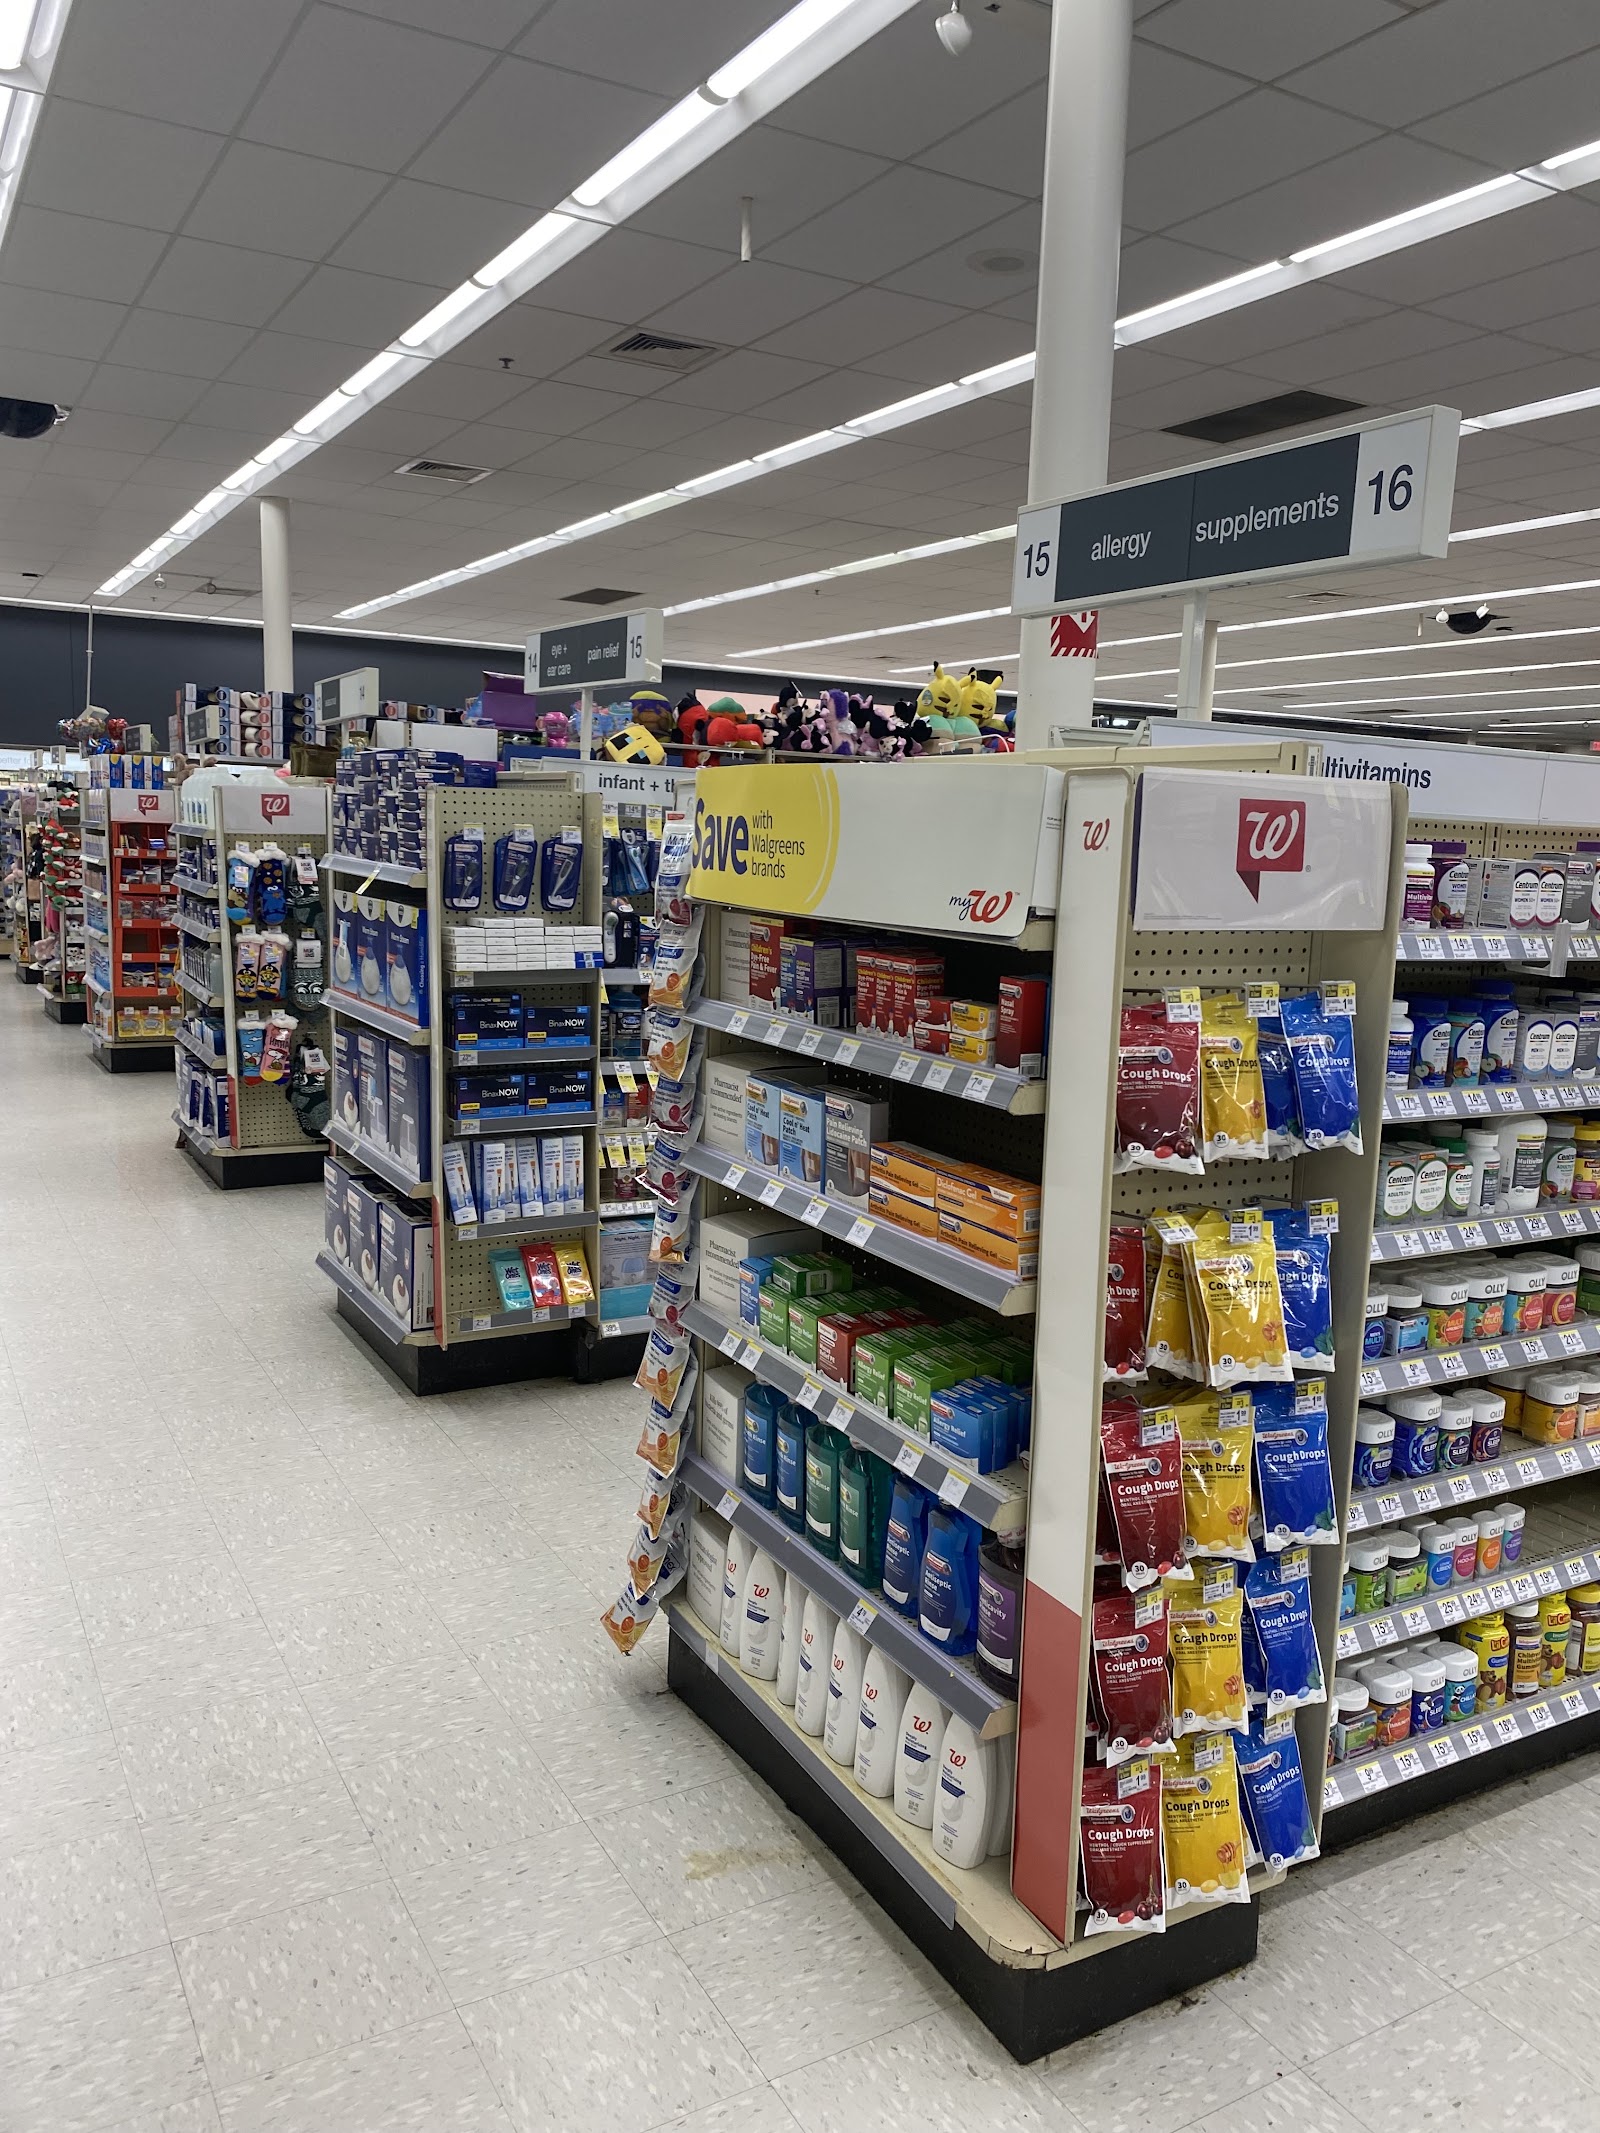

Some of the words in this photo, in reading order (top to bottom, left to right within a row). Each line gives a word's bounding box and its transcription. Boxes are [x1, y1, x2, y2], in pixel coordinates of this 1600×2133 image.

[1367, 464, 1413, 515] 16
[1195, 491, 1340, 543] supplements
[1091, 529, 1151, 561] allergy
[1023, 540, 1050, 578] 15
[552, 644, 562, 658] eye
[630, 636, 642, 658] 15
[588, 647, 601, 664] pain
[603, 642, 620, 658] relief
[528, 653, 537, 673] 14
[547, 666, 555, 677] ear
[558, 663, 571, 675] care
[1322, 756, 1431, 788] ltivitamins
[599, 774, 645, 791] infant
[752, 810, 773, 830] with
[692, 798, 749, 875] Save
[1245, 809, 1299, 860] W
[752, 834, 805, 857] Walgreens
[752, 856, 786, 879] brands
[1515, 881, 1539, 889] Centrum
[1541, 881, 1563, 890] Centrum
[1001, 999, 1014, 1008] Nasal
[1001, 1006, 1014, 1016] Spray
[480, 1021, 518, 1029] BinaxNOW
[549, 1019, 585, 1027] BinaxNOW
[1205, 1058, 1235, 1069] Cough
[1237, 1058, 1258, 1069] Drops
[1298, 1057, 1328, 1068] Cough
[1330, 1057, 1350, 1068] Drop
[1121, 1068, 1160, 1081] Cough
[1162, 1070, 1192, 1082] Drops
[550, 1085, 585, 1094] BinaxNOW
[714, 1077, 739, 1091] Pharmacist
[482, 1088, 519, 1097] BinaxNOW
[710, 1088, 742, 1103] recommended
[783, 1117, 794, 1127] Cool
[800, 1123, 809, 1133] Heat
[827, 1118, 837, 1128] Pain
[838, 1122, 863, 1137] Relieving
[783, 1126, 796, 1136] Patch
[826, 1127, 850, 1141] Lidocaine
[852, 1135, 867, 1147] Patch
[1388, 1175, 1414, 1184] Centrum
[1420, 1169, 1447, 1180] Centrum
[937, 1178, 965, 1197] Diclofenac
[966, 1189, 977, 1199] Gel
[710, 1240, 736, 1257] Pharmacist
[706, 1250, 740, 1269] recommended
[1278, 1272, 1299, 1283] ugh
[1561, 1270, 1578, 1281] OLLY
[1209, 1280, 1243, 1291] Cough
[1245, 1280, 1272, 1290] Drops
[1529, 1278, 1546, 1288] OLLY
[1117, 1286, 1140, 1298] Drops
[1485, 1284, 1505, 1294] OLLY
[1451, 1290, 1468, 1300] OLLY
[1366, 1303, 1385, 1314] OLLY
[1160, 1343, 1168, 1351] 30
[1222, 1358, 1232, 1366] 30
[858, 1361, 872, 1374] Allergy
[873, 1368, 885, 1380] Relief
[897, 1384, 913, 1398] Allergy
[914, 1392, 927, 1405] Relief
[1565, 1392, 1579, 1400] OLLY
[1428, 1407, 1441, 1416] OLLY
[1490, 1409, 1505, 1419] OLLY
[1456, 1417, 1472, 1426] OLLY
[934, 1417, 950, 1431] Allergy
[951, 1424, 966, 1438] Relief
[1377, 1429, 1394, 1439] OLLY
[1265, 1452, 1299, 1463] Cough
[1300, 1449, 1326, 1460] Drops
[1216, 1463, 1245, 1473] Drops
[1375, 1460, 1392, 1469] SLEEP
[1118, 1483, 1153, 1496] Cough
[1155, 1479, 1179, 1492] Drops
[1490, 1526, 1504, 1536] OLLY
[1185, 1538, 1195, 1546] 30
[1462, 1533, 1477, 1543] OLLY
[1439, 1542, 1455, 1552] OLLY
[1374, 1555, 1389, 1565] OLLY
[1135, 1565, 1145, 1573] 30
[925, 1570, 952, 1591] Antiseptic
[1260, 1616, 1293, 1628] Cough
[1290, 1611, 1308, 1625] Drops
[1174, 1634, 1208, 1645] Cough
[1210, 1632, 1237, 1641] Drops
[1105, 1659, 1139, 1673] Cough
[1141, 1655, 1164, 1668] Drop
[1463, 1667, 1477, 1677] OLLY
[1431, 1677, 1445, 1687] OLLY
[1396, 1688, 1411, 1698] OLLY
[1115, 1740, 1124, 1748] 30
[1253, 1781, 1277, 1795] Cough
[1277, 1766, 1300, 1782] Drops
[1166, 1802, 1200, 1814] Cough
[1202, 1799, 1230, 1810] Drops
[1088, 1830, 1124, 1843] Cough
[1126, 1828, 1154, 1840] Drops
[1272, 1856, 1282, 1864] 30
[1177, 1881, 1187, 1889] 30
